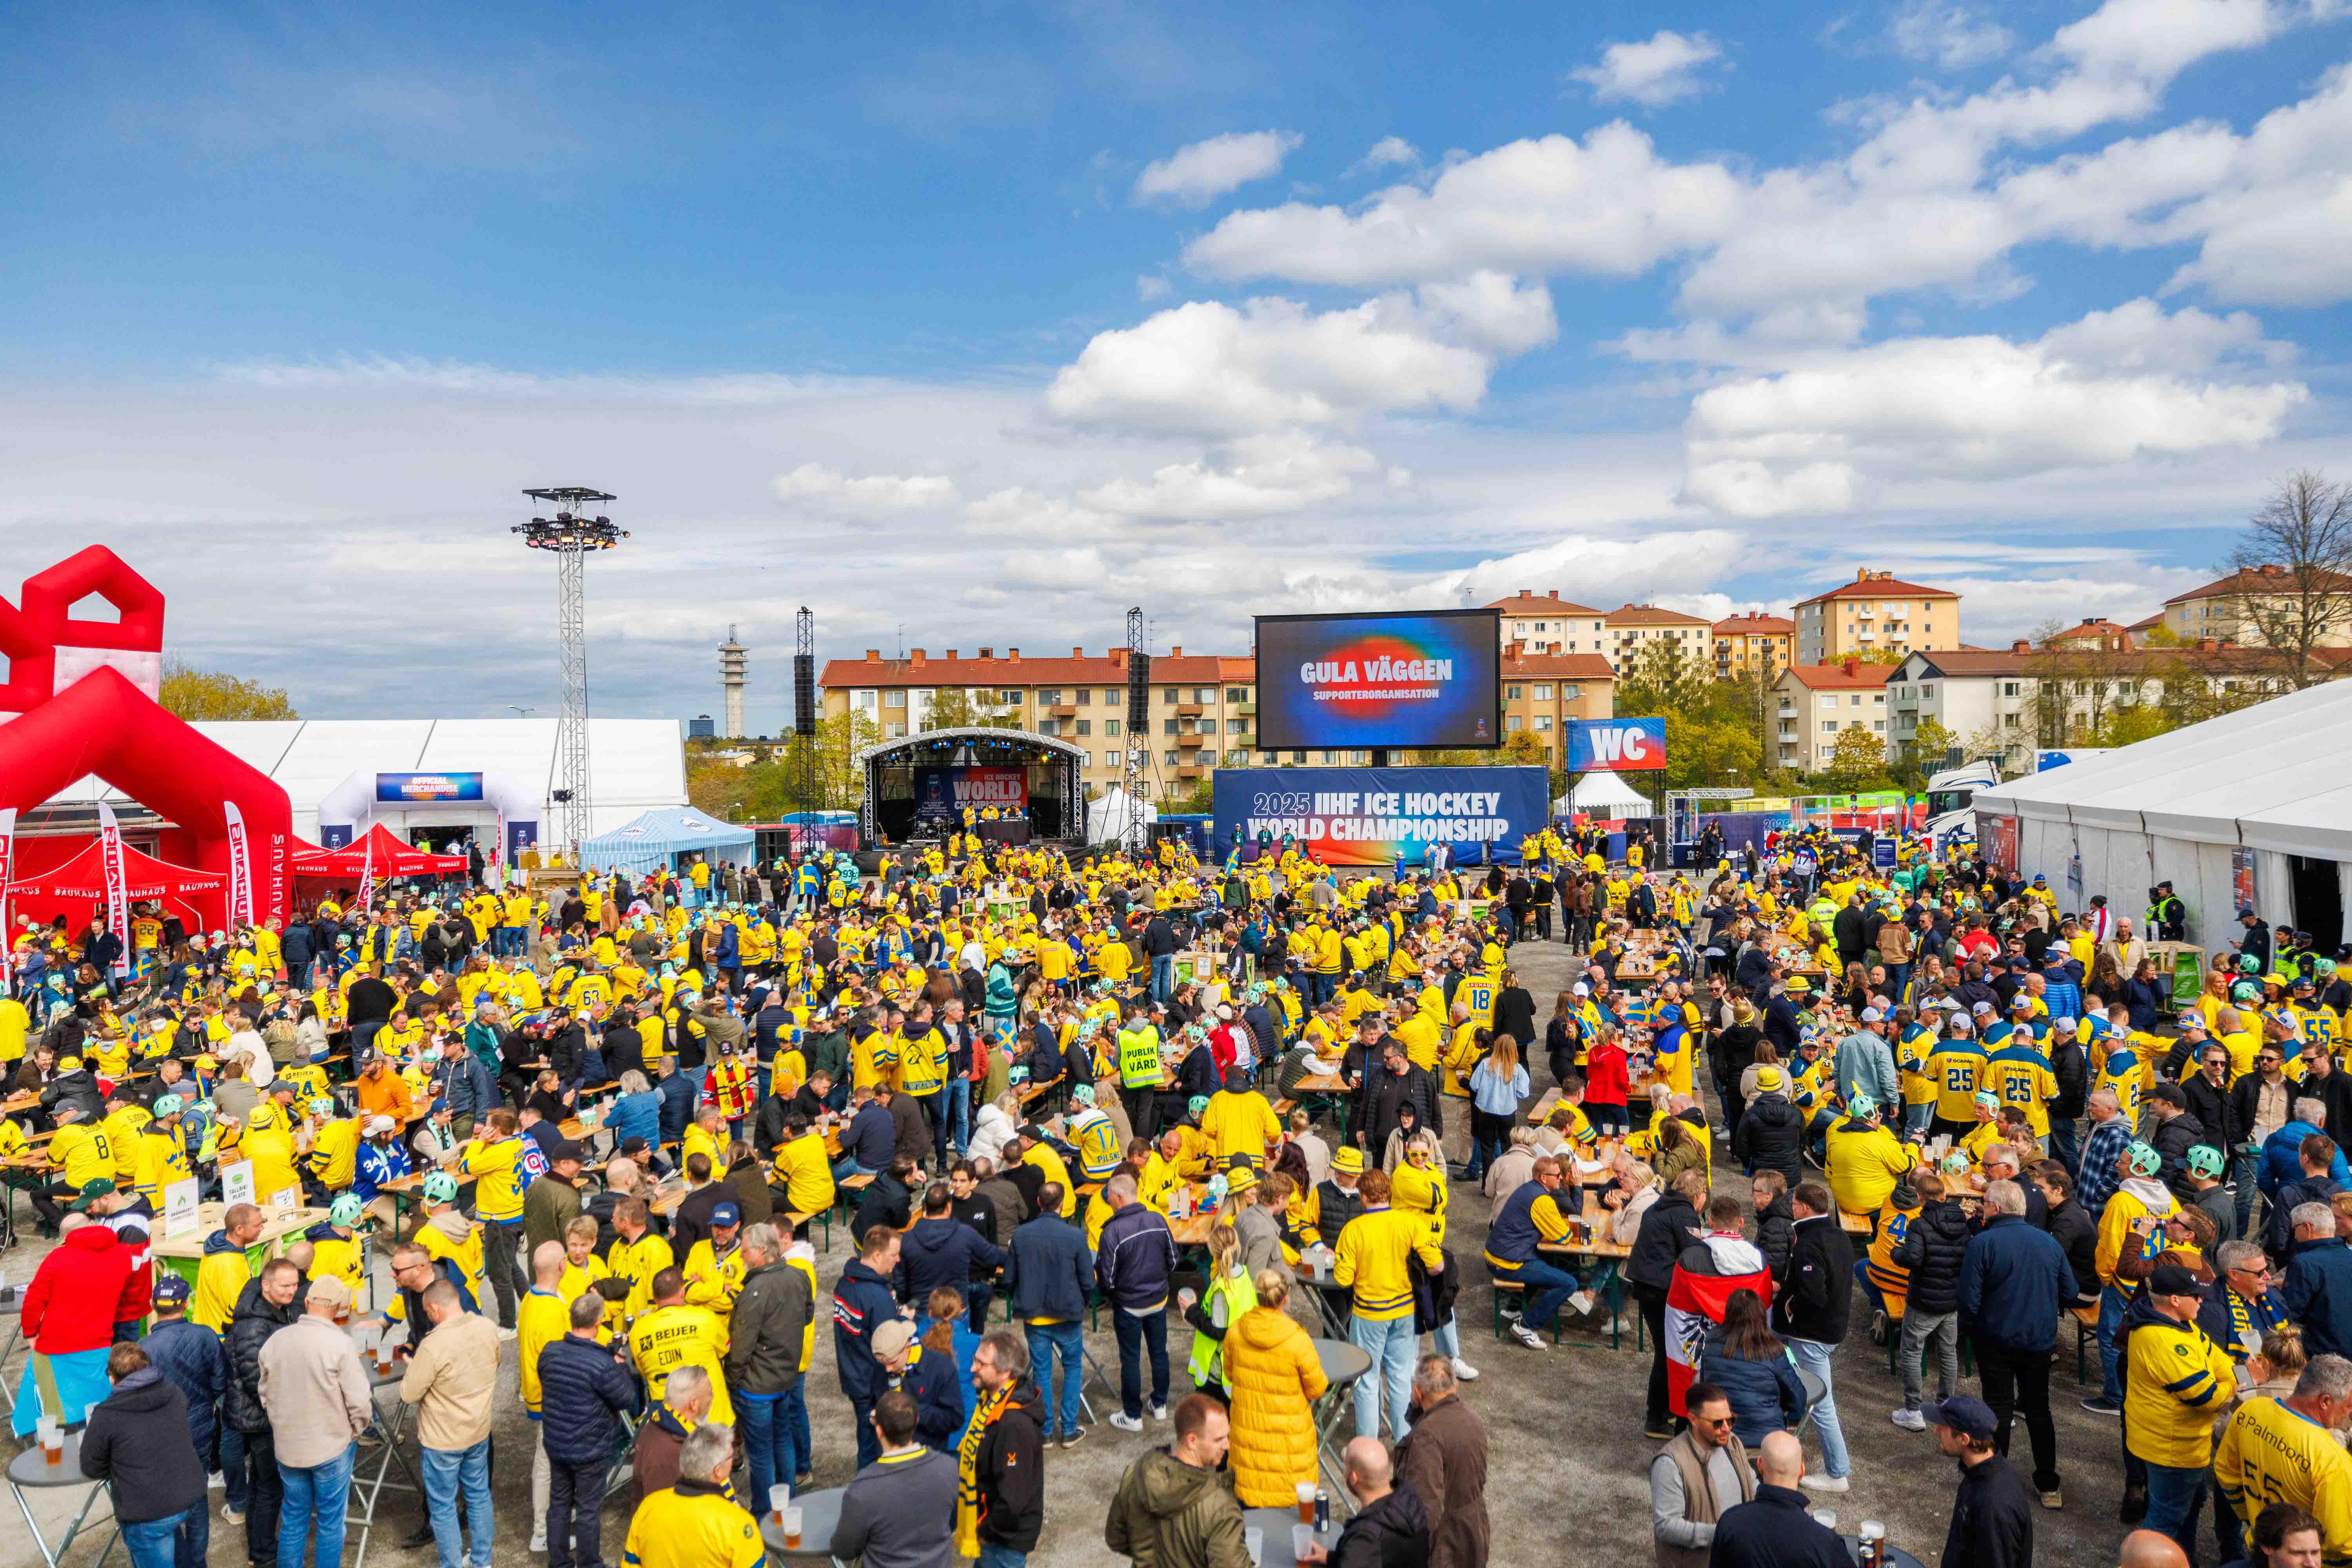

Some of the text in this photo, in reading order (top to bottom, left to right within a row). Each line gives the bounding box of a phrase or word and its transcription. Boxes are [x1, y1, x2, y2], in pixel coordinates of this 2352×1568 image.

[1301, 655, 1452, 684] GULA VÄGGEN
[1314, 688, 1439, 700] SUPPORTERORGANISATION
[1590, 727, 1646, 761] WC
[953, 781, 1022, 800] WORLD
[1253, 792, 1500, 816] 2025 IIHF ICE HOCKEY
[1248, 818, 1508, 842] WORLD CHAMPIONSHIP
[7, 887, 40, 896] UHAUS
[54, 888, 101, 898] BAUHAUS
[179, 881, 220, 892] BAUHAUS
[583, 990, 599, 1006] 63
[1472, 989, 1490, 1010] 18
[2304, 1019, 2330, 1045] 55
[1127, 1047, 1155, 1060] PUBLIK
[1903, 1049, 1914, 1060] 25
[1129, 1058, 1157, 1072] VÄRD
[1947, 1068, 1974, 1092] 25
[1793, 1083, 1806, 1094] 25
[2005, 1077, 2031, 1103] 25
[1096, 1124, 1114, 1151] 17
[94, 1135, 109, 1159] 8
[1097, 1151, 1121, 1163] PILSNE
[363, 1158, 383, 1174] 34
[232, 1192, 246, 1200] PLATE
[655, 1325, 697, 1341] BEIJER
[658, 1347, 682, 1367] EDIN
